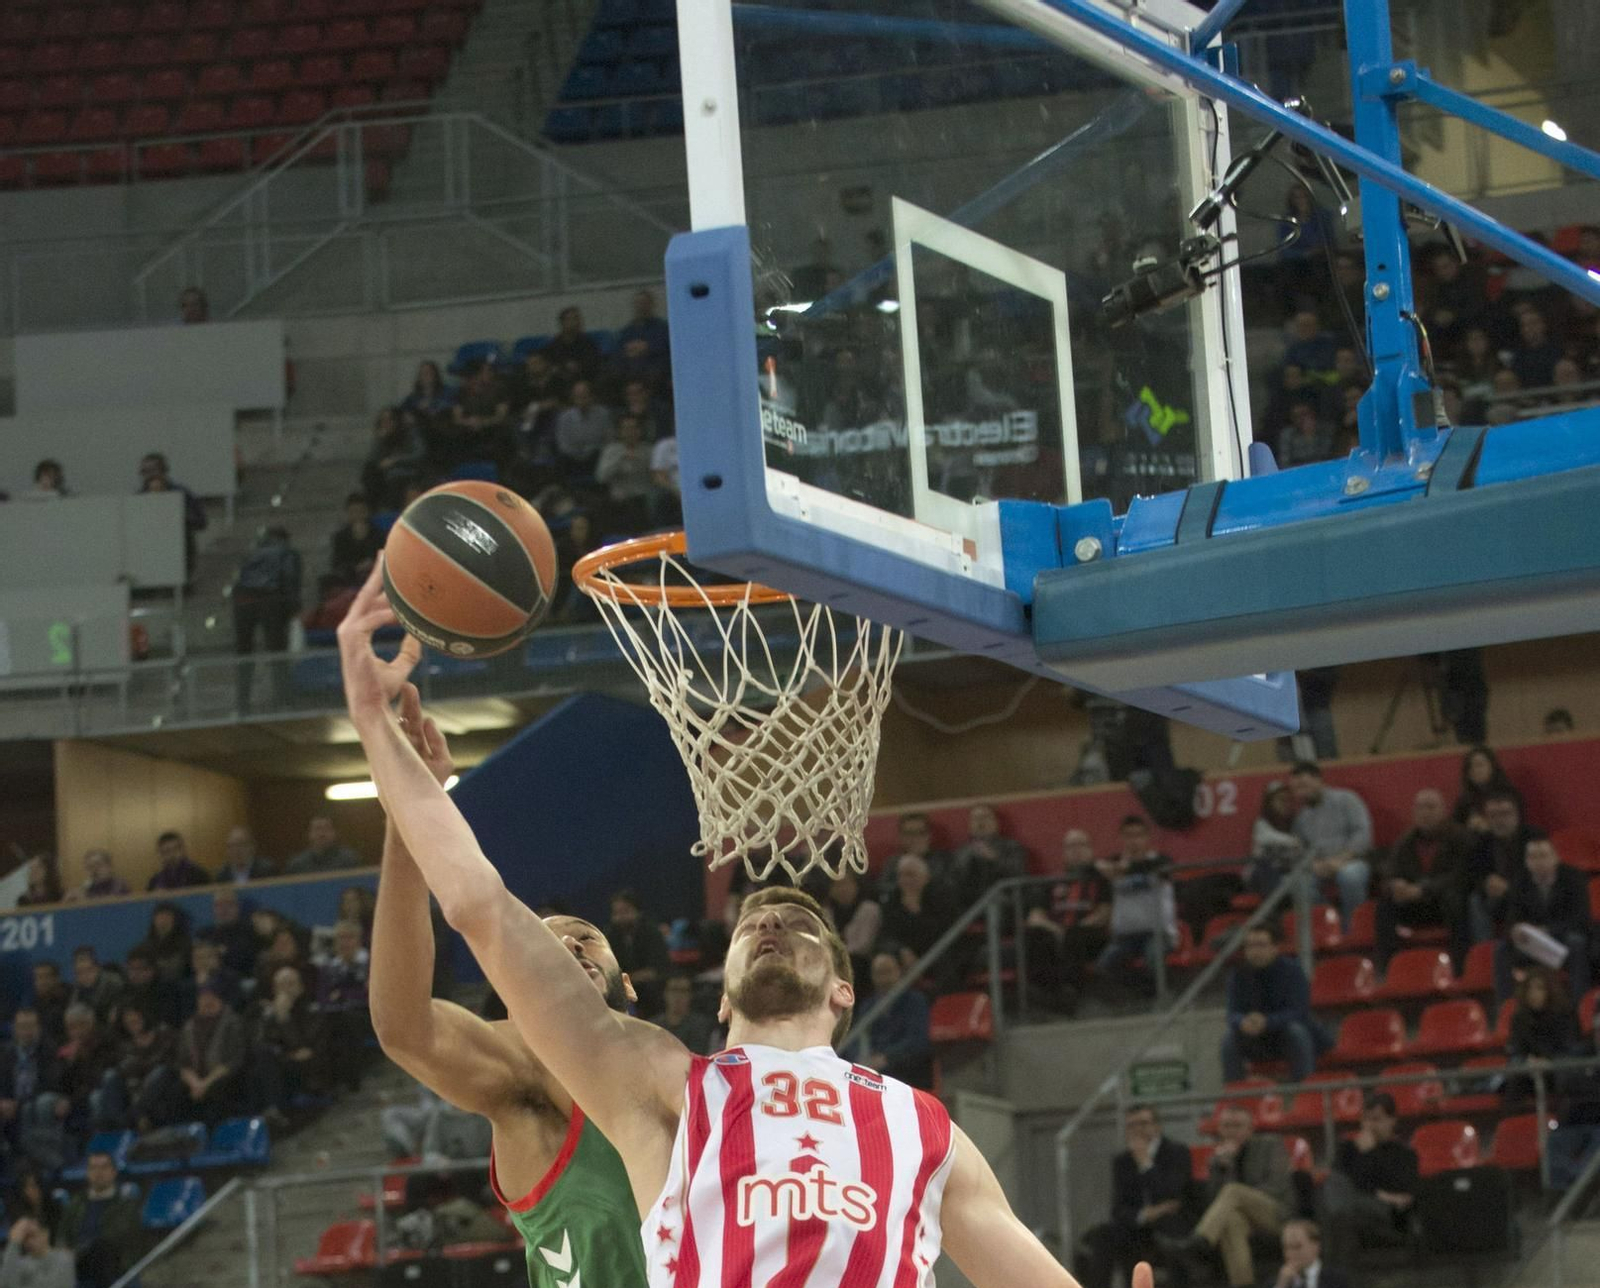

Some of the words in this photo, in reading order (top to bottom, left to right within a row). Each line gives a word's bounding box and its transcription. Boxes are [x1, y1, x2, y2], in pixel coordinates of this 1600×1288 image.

[1193, 780, 1238, 818] 02
[0, 913, 55, 953] 201
[761, 1069, 846, 1127] 32
[741, 1167, 873, 1226] mts
